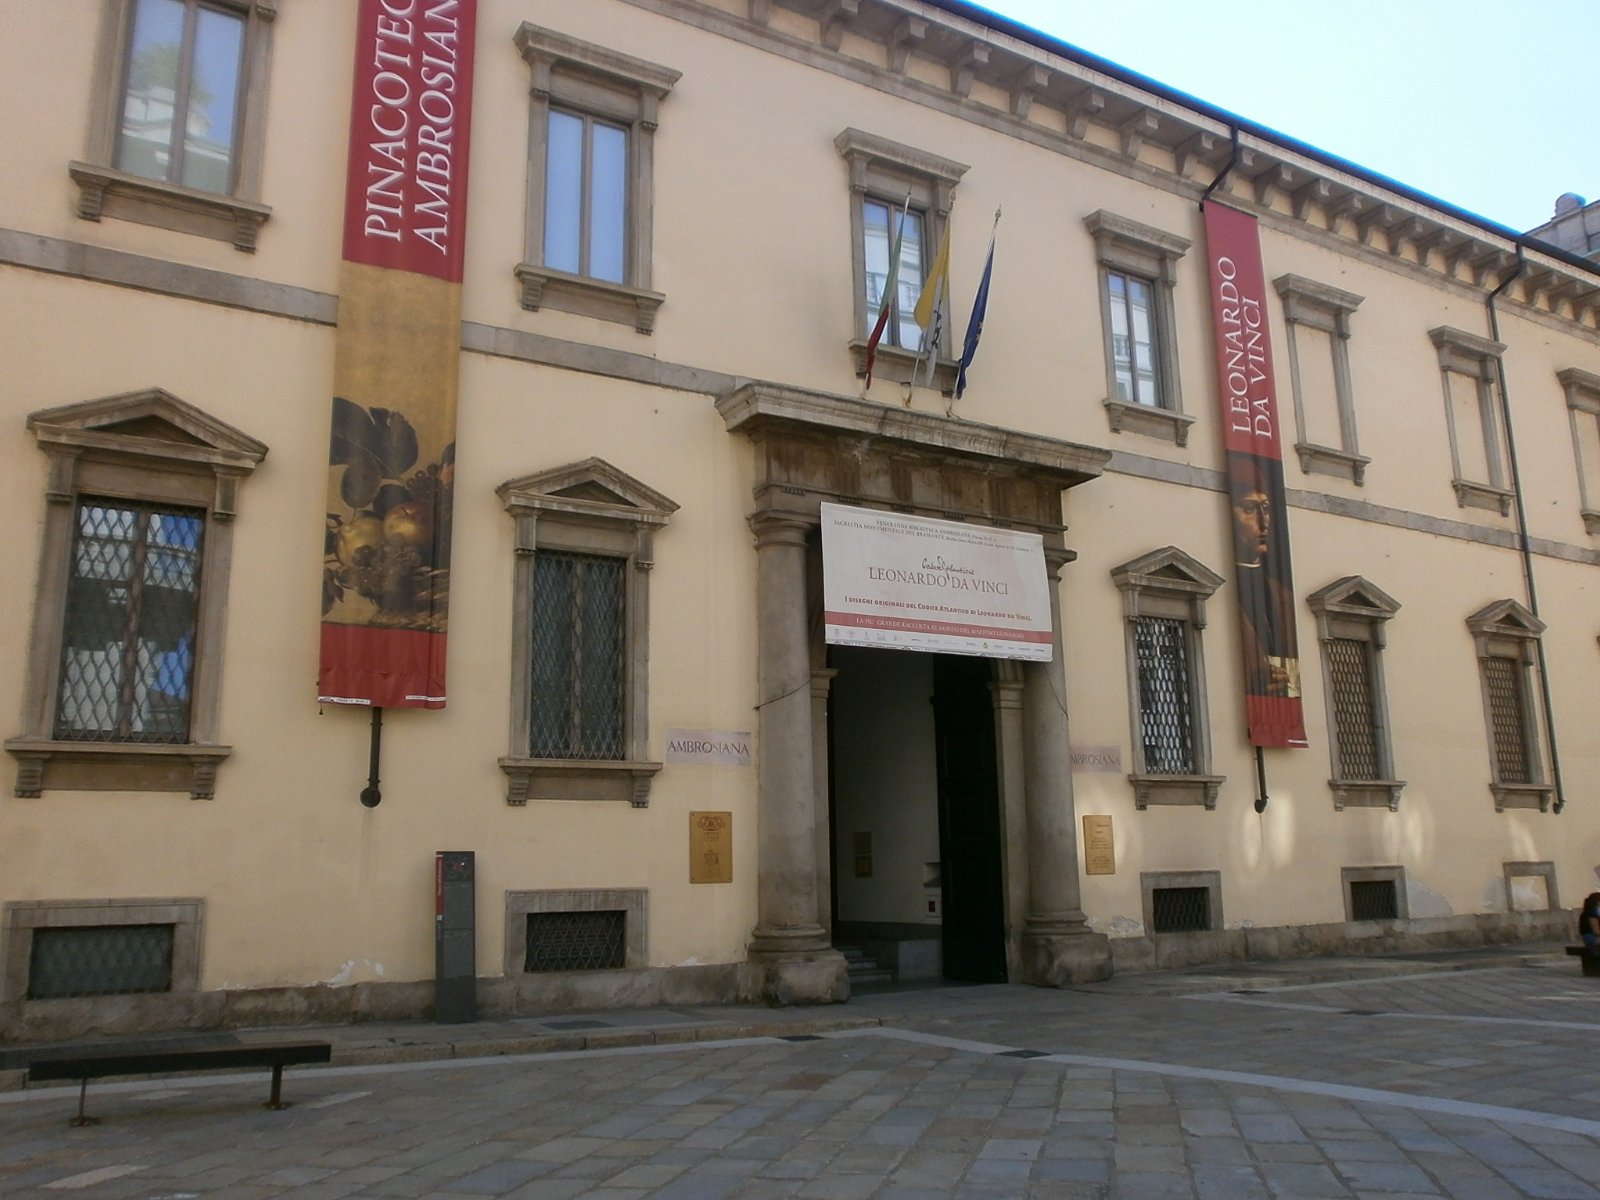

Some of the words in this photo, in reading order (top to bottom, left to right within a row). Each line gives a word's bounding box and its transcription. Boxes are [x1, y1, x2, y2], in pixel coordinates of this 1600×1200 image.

[1217, 256, 1251, 434] LEONARDO
[1243, 296, 1267, 385] VINCI
[1255, 396, 1272, 440] DA
[868, 566, 947, 588] LEONARDO
[951, 576, 969, 590] DA
[971, 578, 1009, 595] VINCI
[848, 597, 873, 605] DISEGNI
[874, 599, 905, 608] ORIGINALI
[917, 603, 938, 611] CODICE
[939, 605, 970, 614] ATLANTICO
[977, 609, 1006, 618] LEONARDO
[667, 740, 750, 757] AMBROSIANA
[1070, 753, 1121, 766] MBROSIANA
